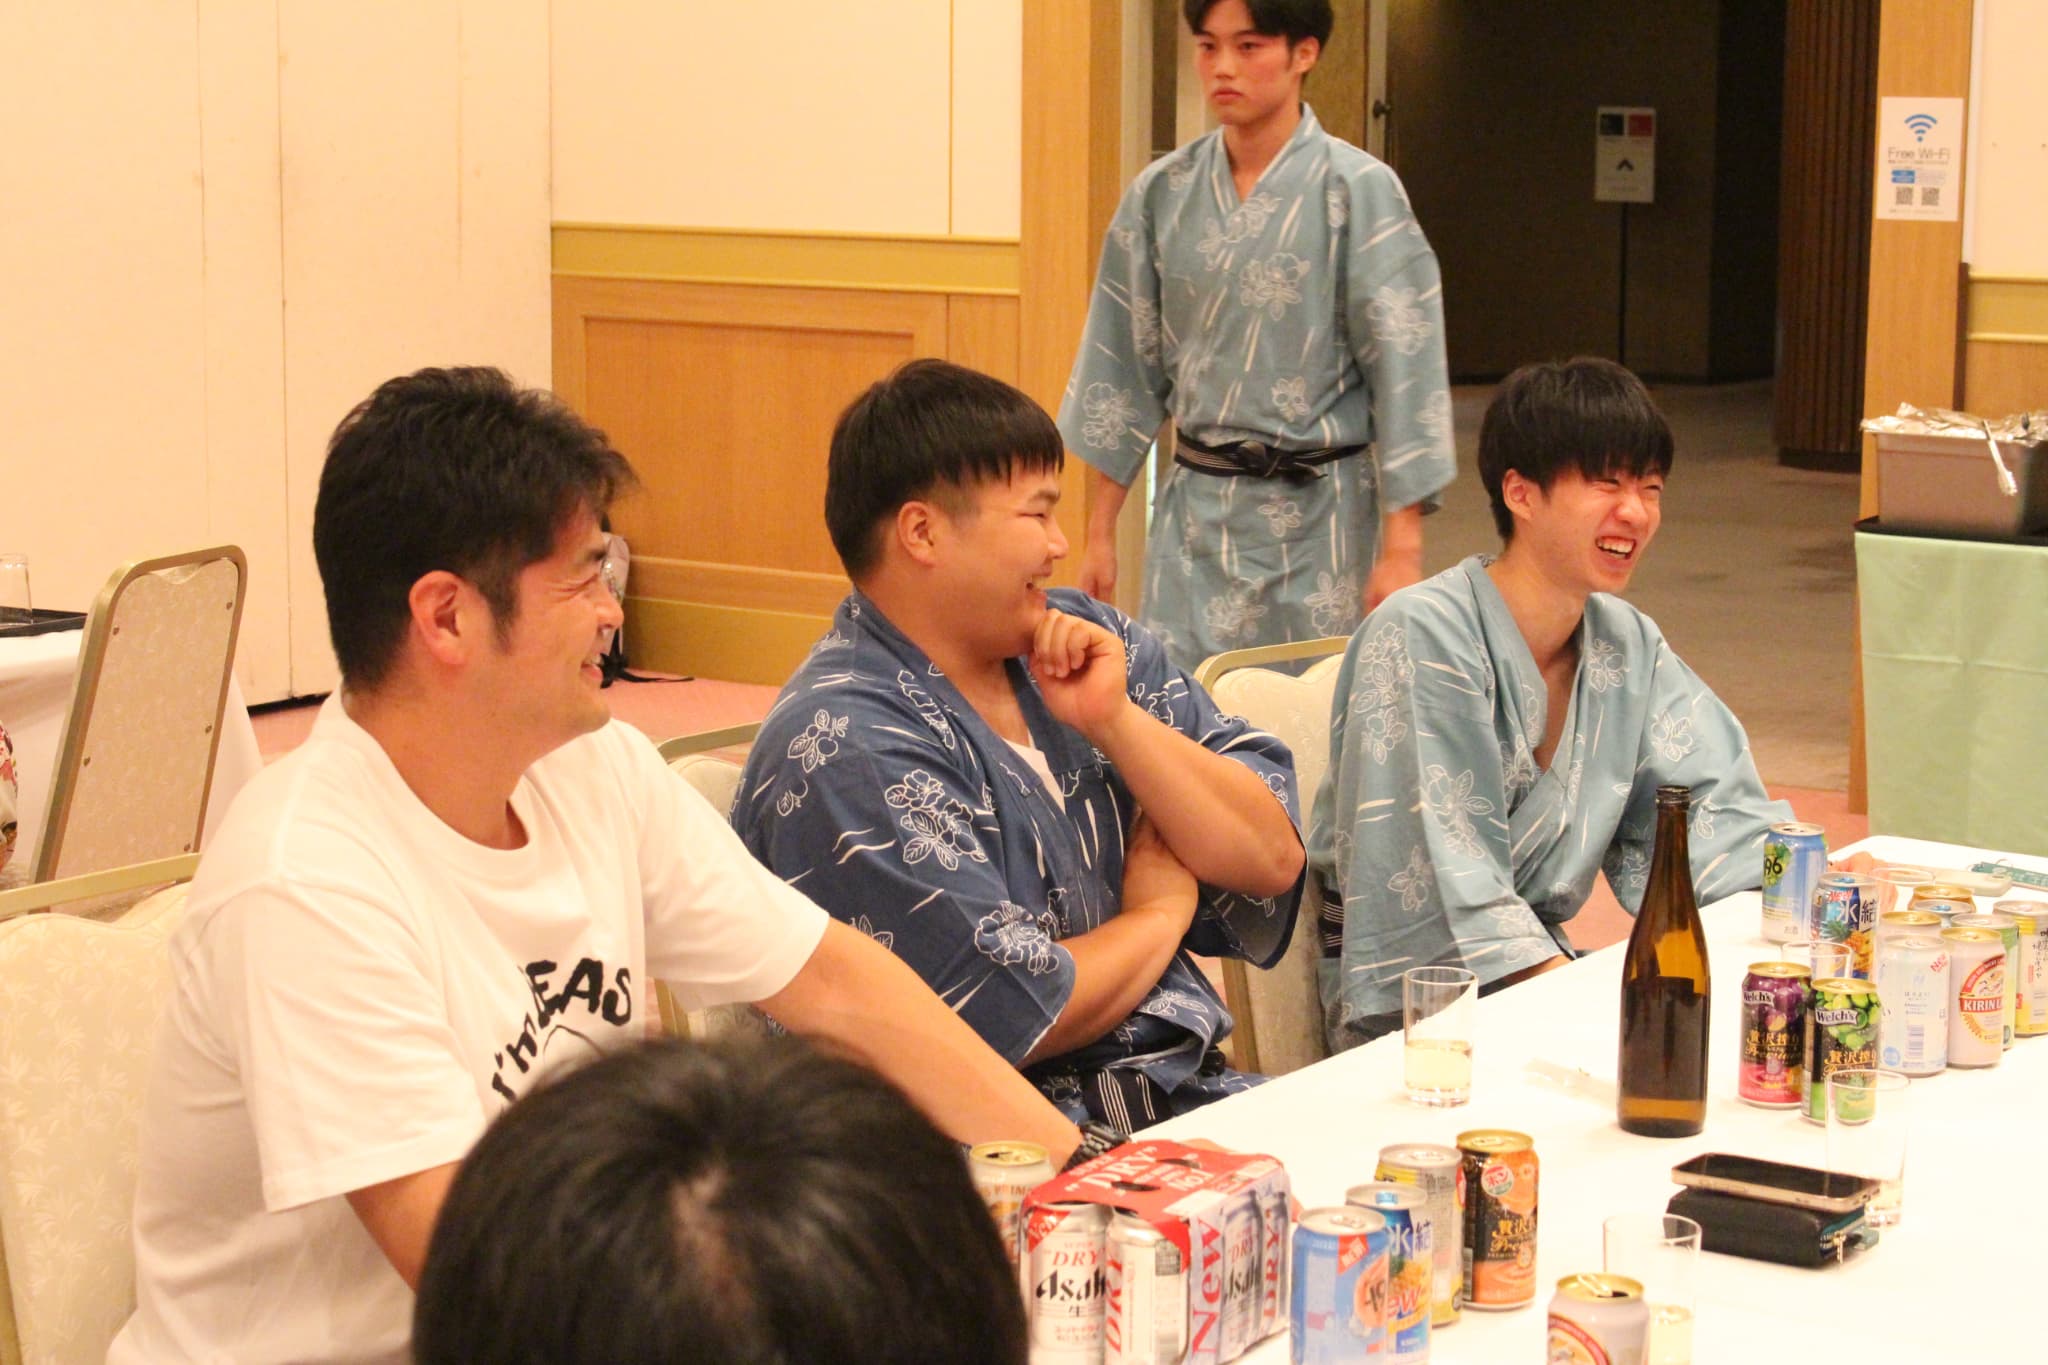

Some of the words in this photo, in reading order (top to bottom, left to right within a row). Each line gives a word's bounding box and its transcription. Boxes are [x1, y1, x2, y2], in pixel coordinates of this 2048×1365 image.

[1887, 146, 1915, 159] Free
[1918, 148, 1951, 160] Wi-Fi
[1815, 1010, 1856, 1022] Welch's
[1191, 1217, 1222, 1358] New
